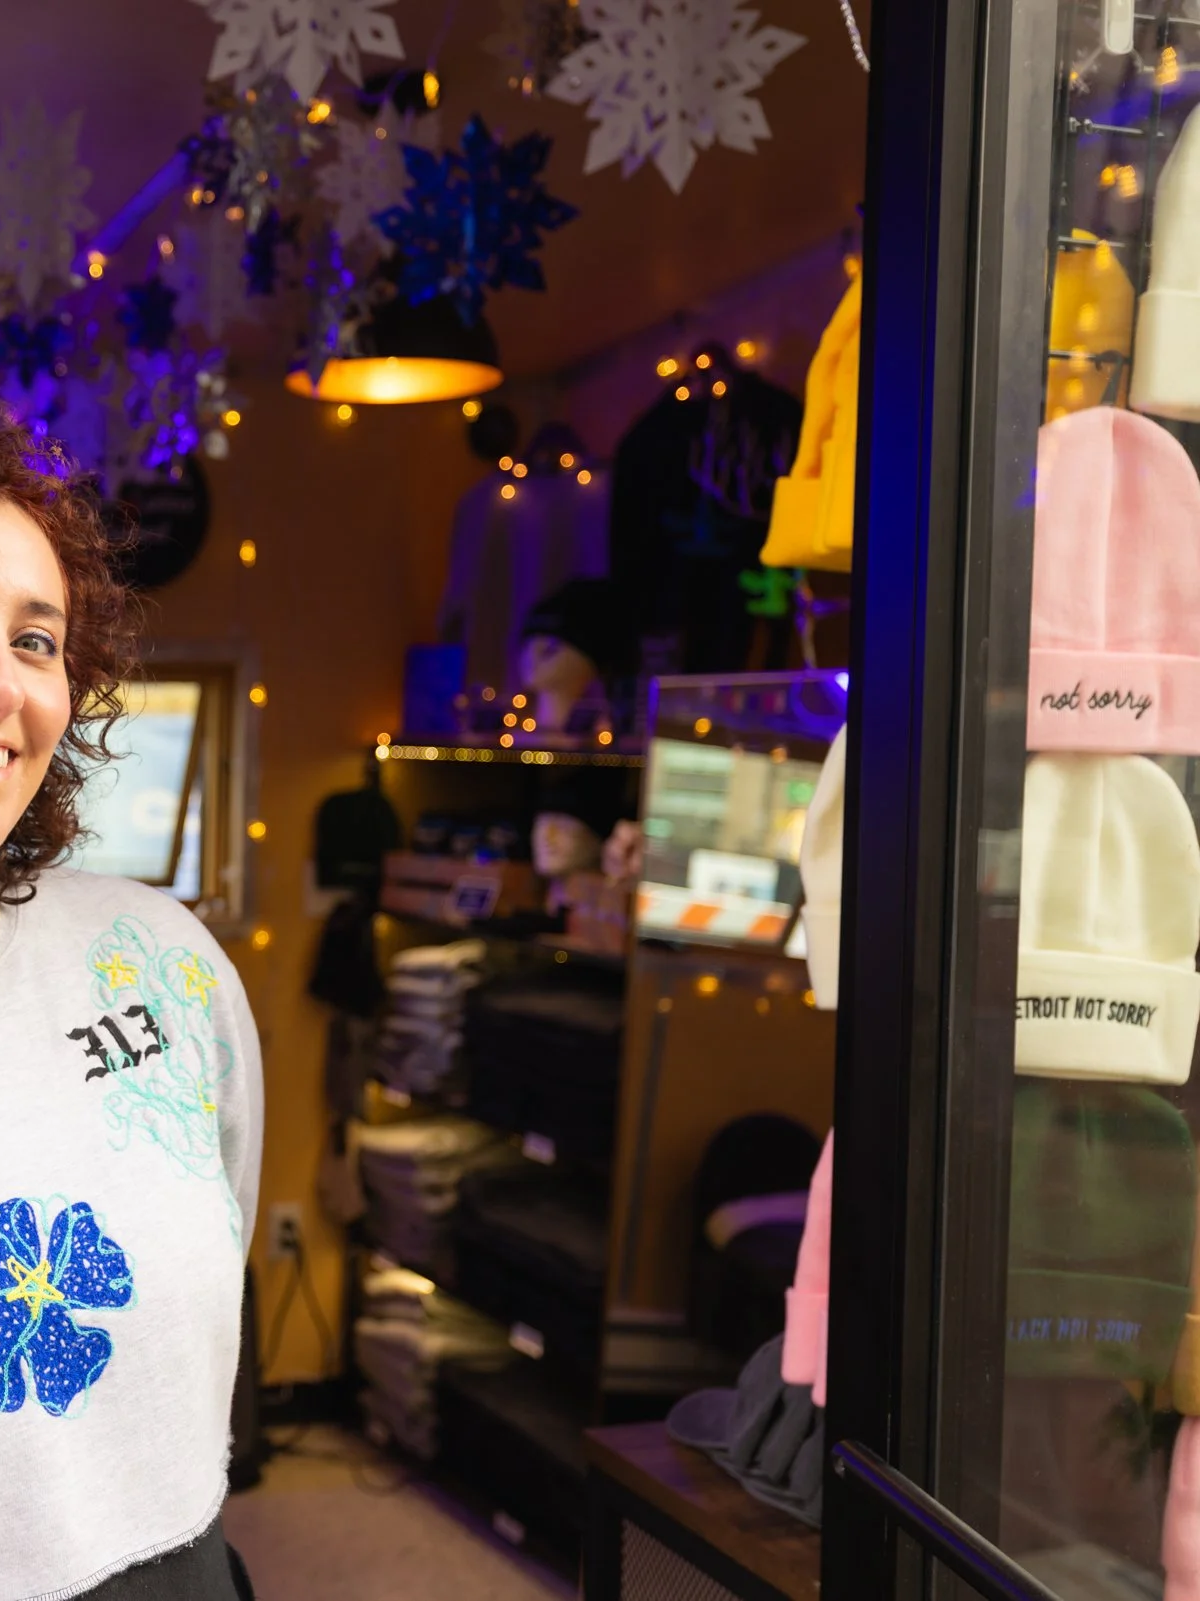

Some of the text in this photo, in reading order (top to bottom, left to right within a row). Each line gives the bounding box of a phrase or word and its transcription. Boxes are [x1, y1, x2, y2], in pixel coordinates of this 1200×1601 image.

[1040, 679, 1152, 720] not sorry
[1015, 996, 1157, 1027] ETROIT NOT SORRY
[65, 1005, 170, 1082] 313
[1007, 1317, 1051, 1342] LACK
